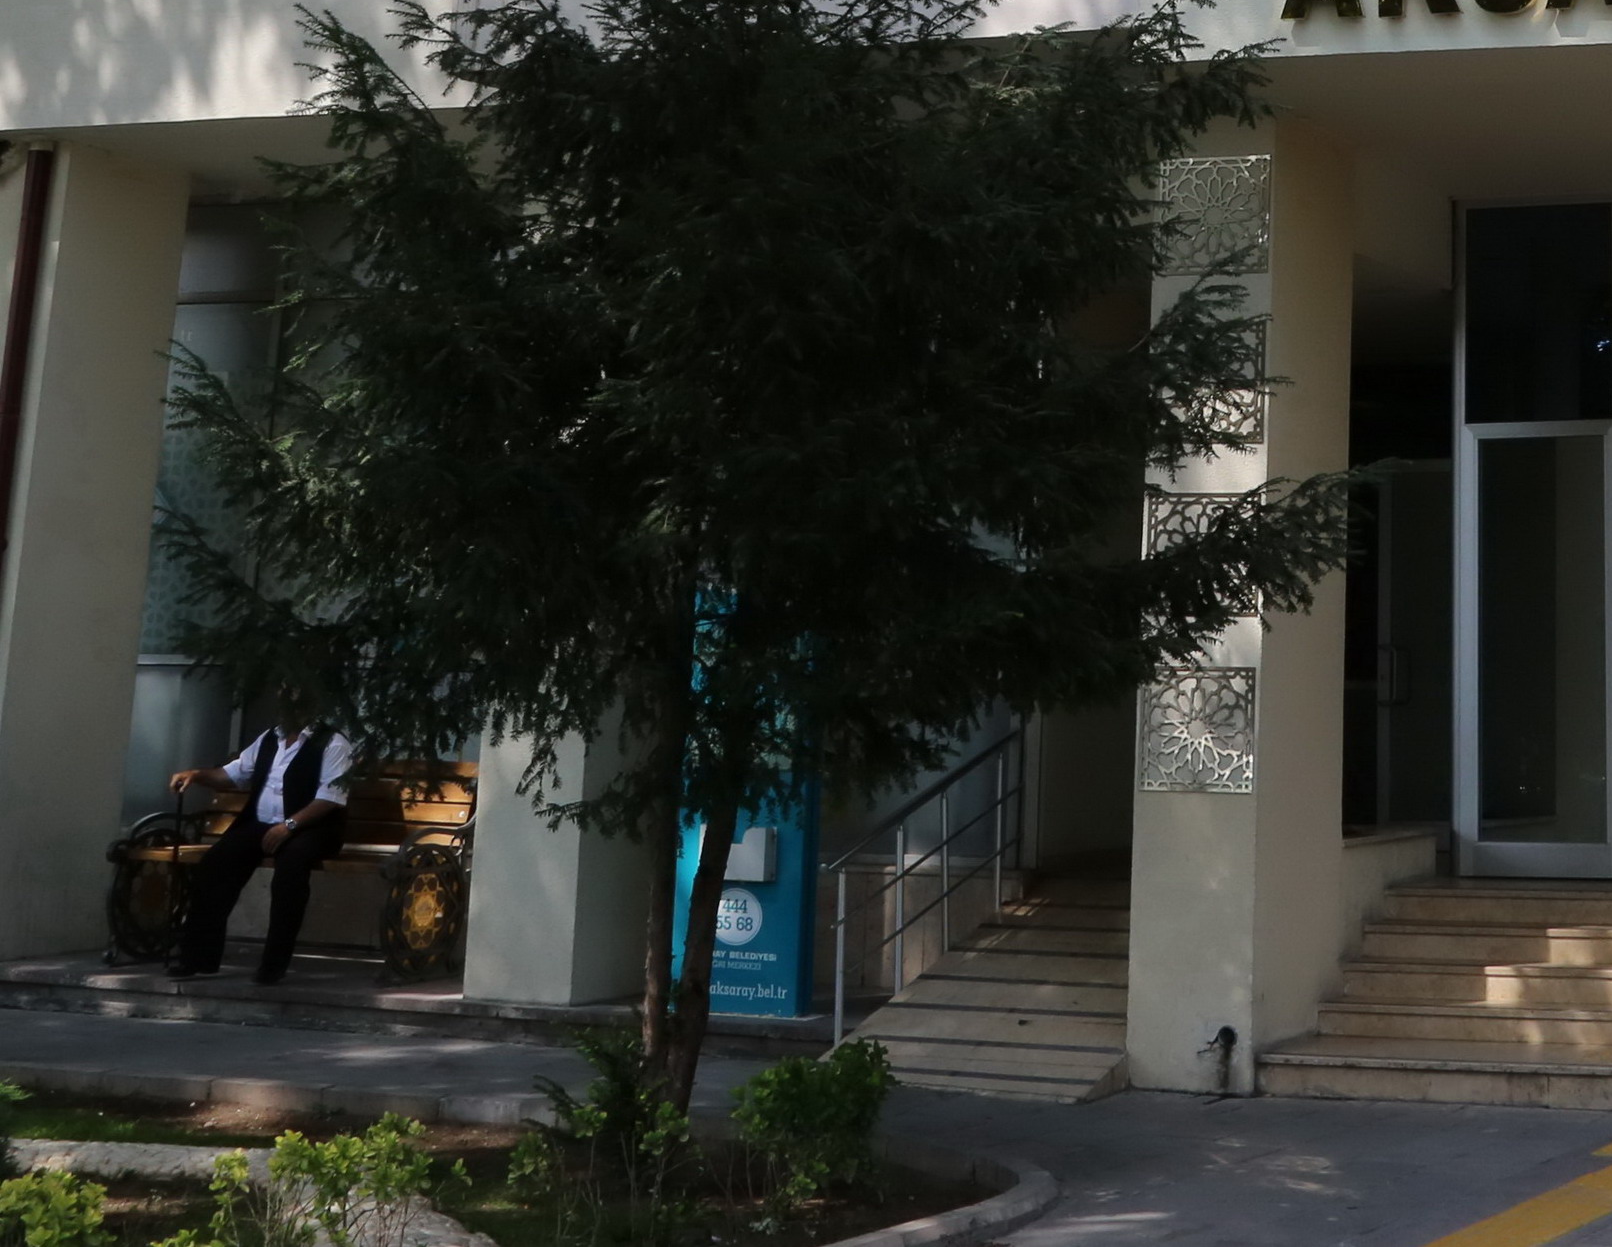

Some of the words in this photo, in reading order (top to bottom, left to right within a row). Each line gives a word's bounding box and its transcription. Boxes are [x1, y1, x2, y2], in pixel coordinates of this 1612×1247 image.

[722, 899, 747, 913] 444
[736, 917, 753, 931] 68
[709, 980, 788, 1001] aksaray.bel.tr
